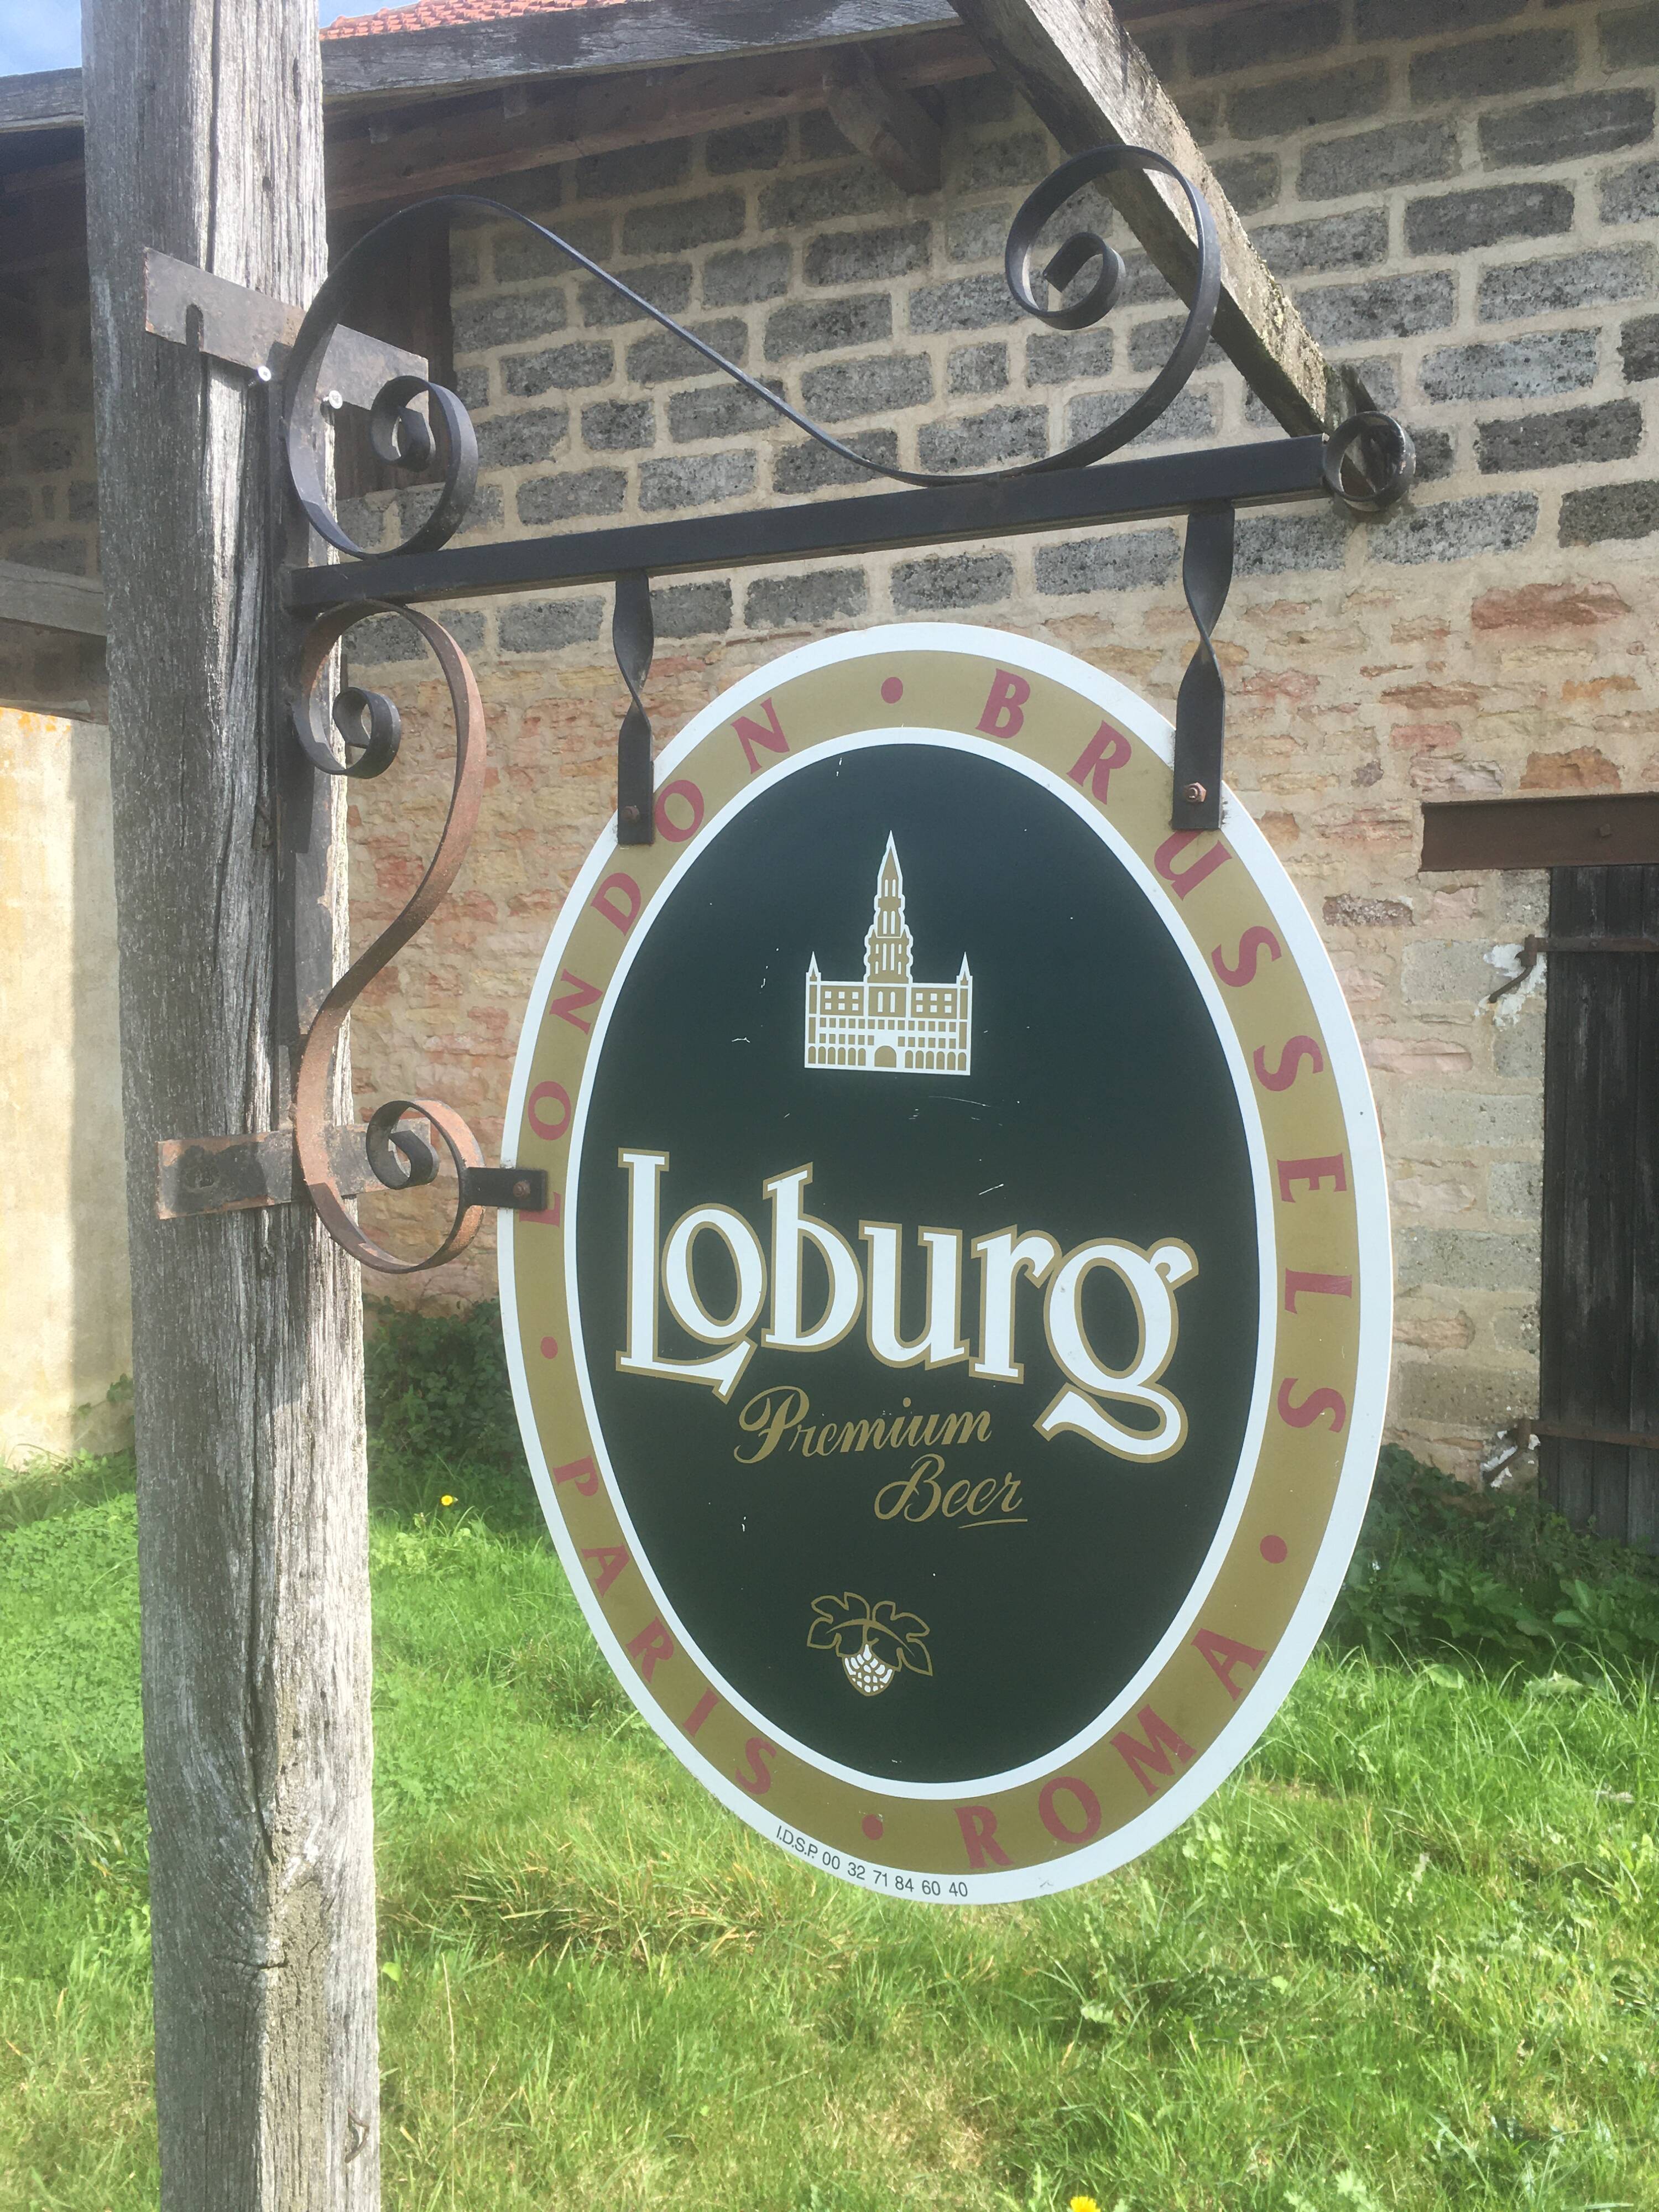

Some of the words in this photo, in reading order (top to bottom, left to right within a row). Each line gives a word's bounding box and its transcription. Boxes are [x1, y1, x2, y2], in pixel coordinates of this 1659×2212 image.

[976, 668, 1352, 1433] BRUSSELS
[615, 1147, 1199, 1463] Loburg
[734, 1386, 992, 1464] Premium
[874, 1453, 1024, 1522] Beer
[554, 1455, 777, 1796] PARIS
[953, 1627, 1266, 1869] ROMA
[822, 1851, 841, 1870] 00
[847, 1862, 866, 1881] 32
[873, 1870, 889, 1887] 71
[894, 1875, 915, 1893] 84
[921, 1880, 941, 1896] 60
[948, 1881, 968, 1897] 40
